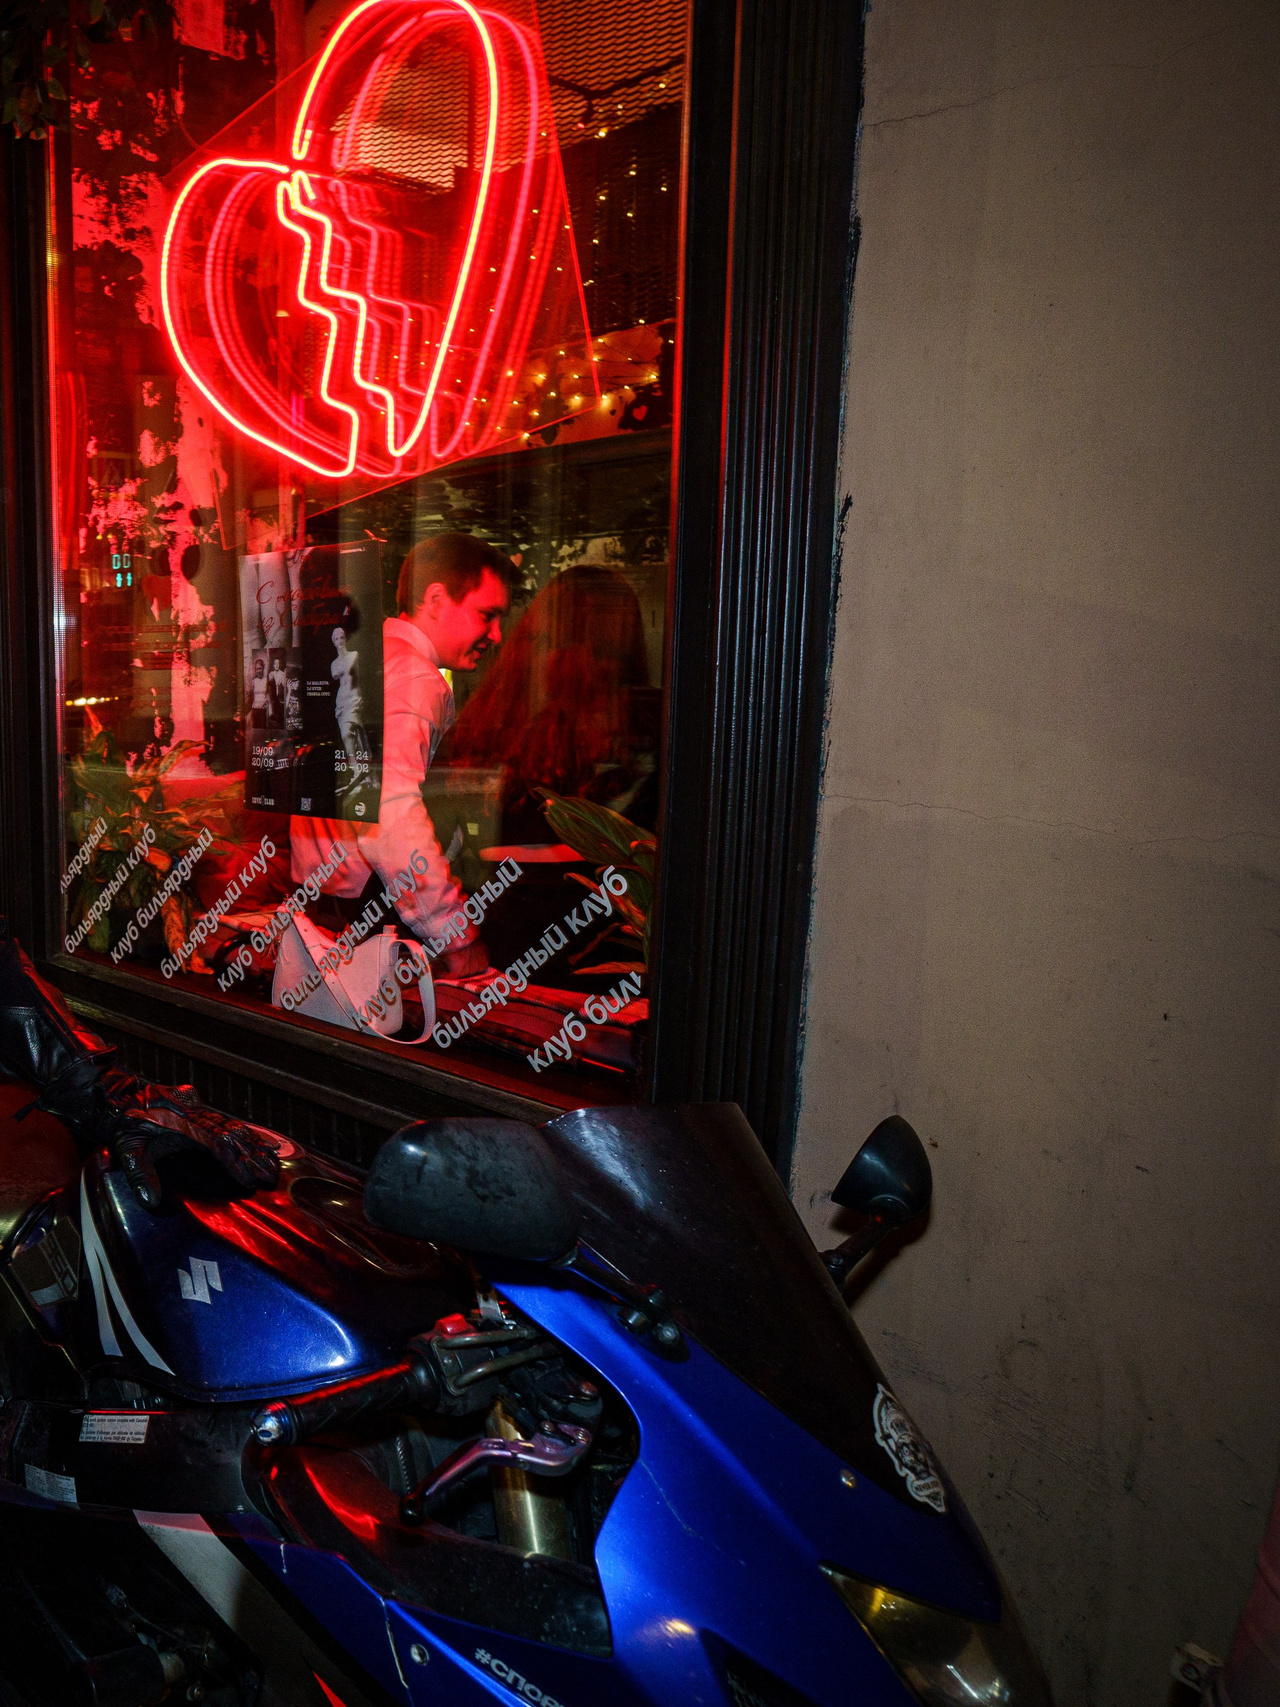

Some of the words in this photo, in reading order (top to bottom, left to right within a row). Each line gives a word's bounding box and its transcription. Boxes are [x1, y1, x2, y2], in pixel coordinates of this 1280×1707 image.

[252, 746, 274, 756] 19/09
[252, 758, 274, 768] 20/09
[334, 750, 346, 760] 21
[356, 751, 369, 761] 24
[334, 763, 347, 772] 20
[356, 763, 369, 773] 02
[64, 862, 130, 954] бильярдный
[126, 822, 156, 870] клуб
[110, 920, 139, 964] клуб
[136, 826, 214, 929] бильярдный
[160, 879, 242, 979] бильярдный
[238, 834, 276, 888] клуб
[217, 943, 253, 992] клуб
[250, 841, 349, 953] бильярдный
[280, 899, 384, 1011] бильярдный
[379, 848, 428, 909] клуб
[351, 973, 398, 1031] клуб
[394, 855, 523, 985] бильярдный
[431, 923, 569, 1048] бильярдный
[564, 865, 628, 935] клуб
[526, 1011, 587, 1073] клуб
